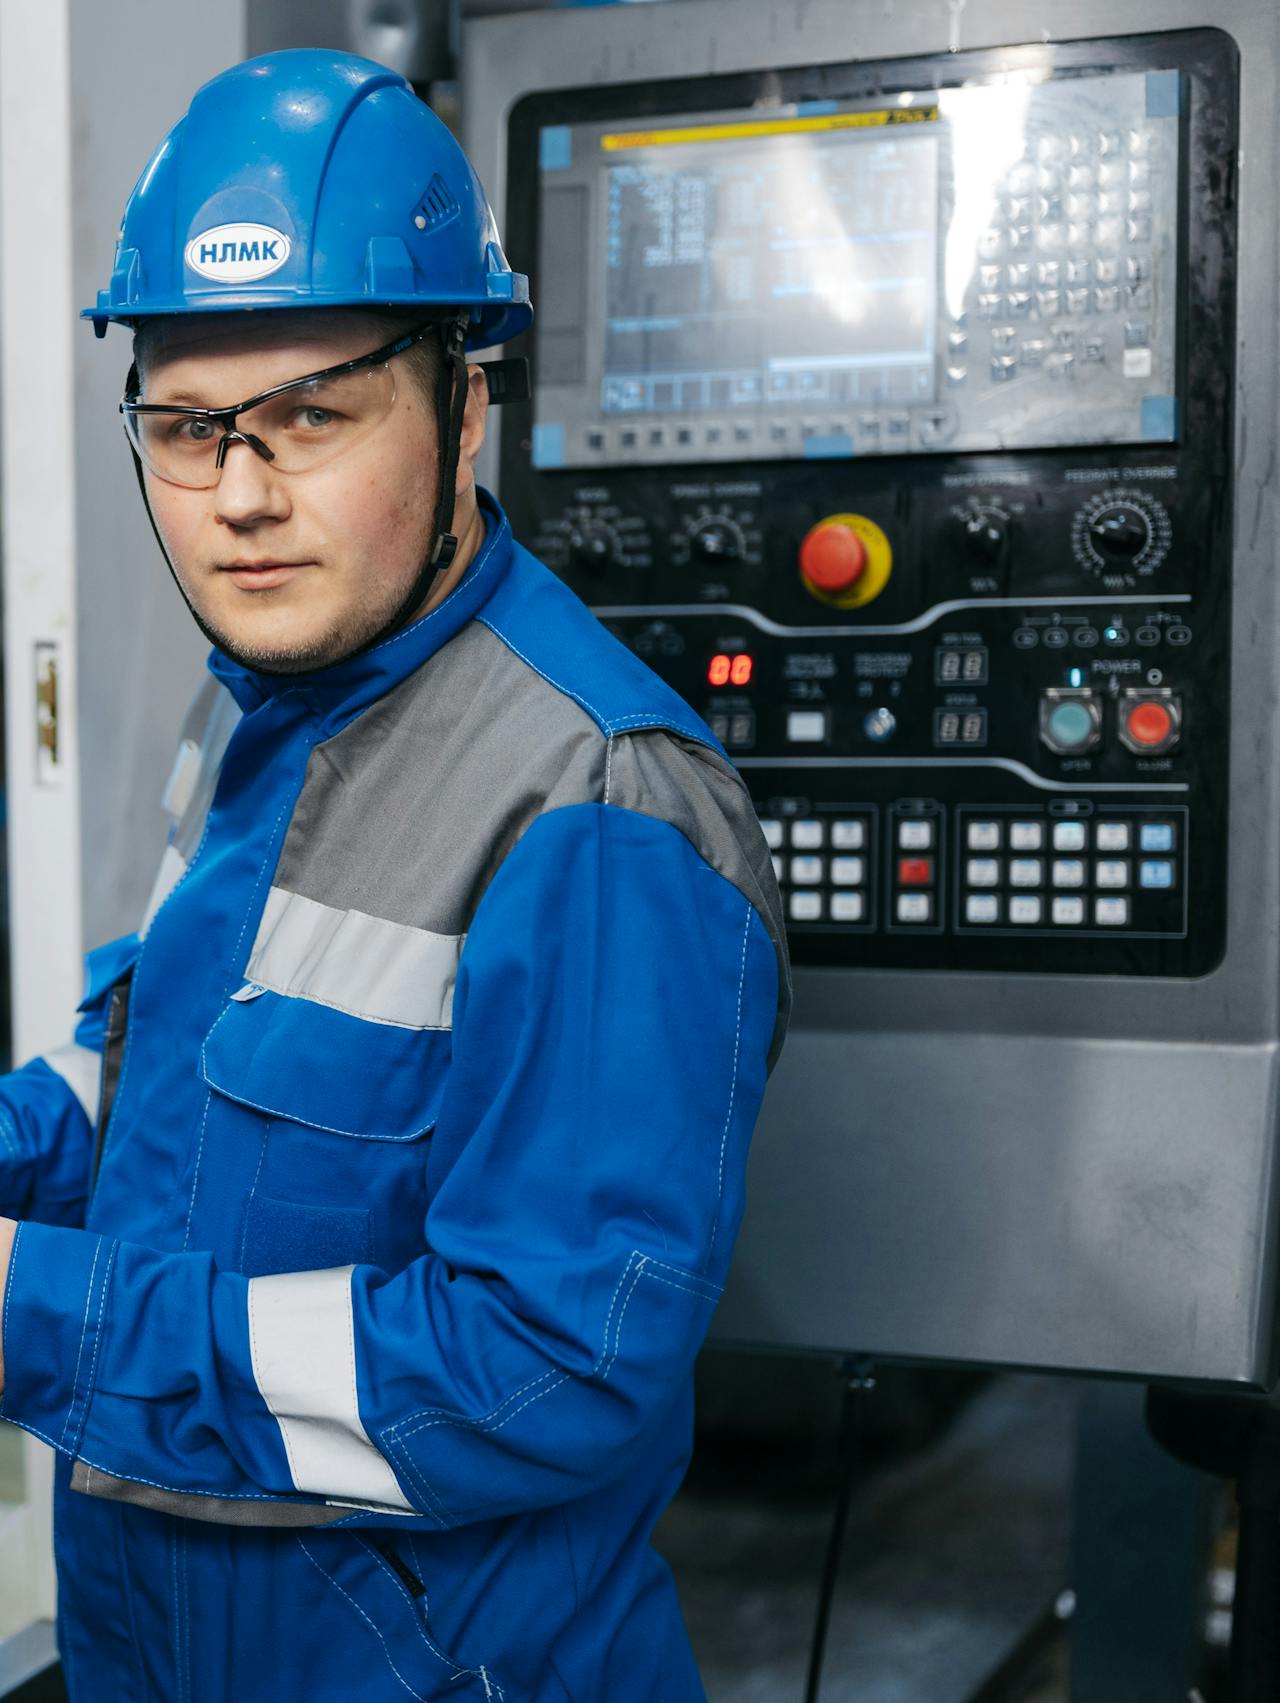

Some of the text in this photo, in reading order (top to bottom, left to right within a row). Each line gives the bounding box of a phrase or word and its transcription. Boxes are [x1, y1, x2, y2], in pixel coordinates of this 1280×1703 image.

[199, 240, 280, 263] НЛМК
[1064, 466, 1177, 483] FEEDRATE OVERRIDE
[1092, 659, 1141, 673] POWER
